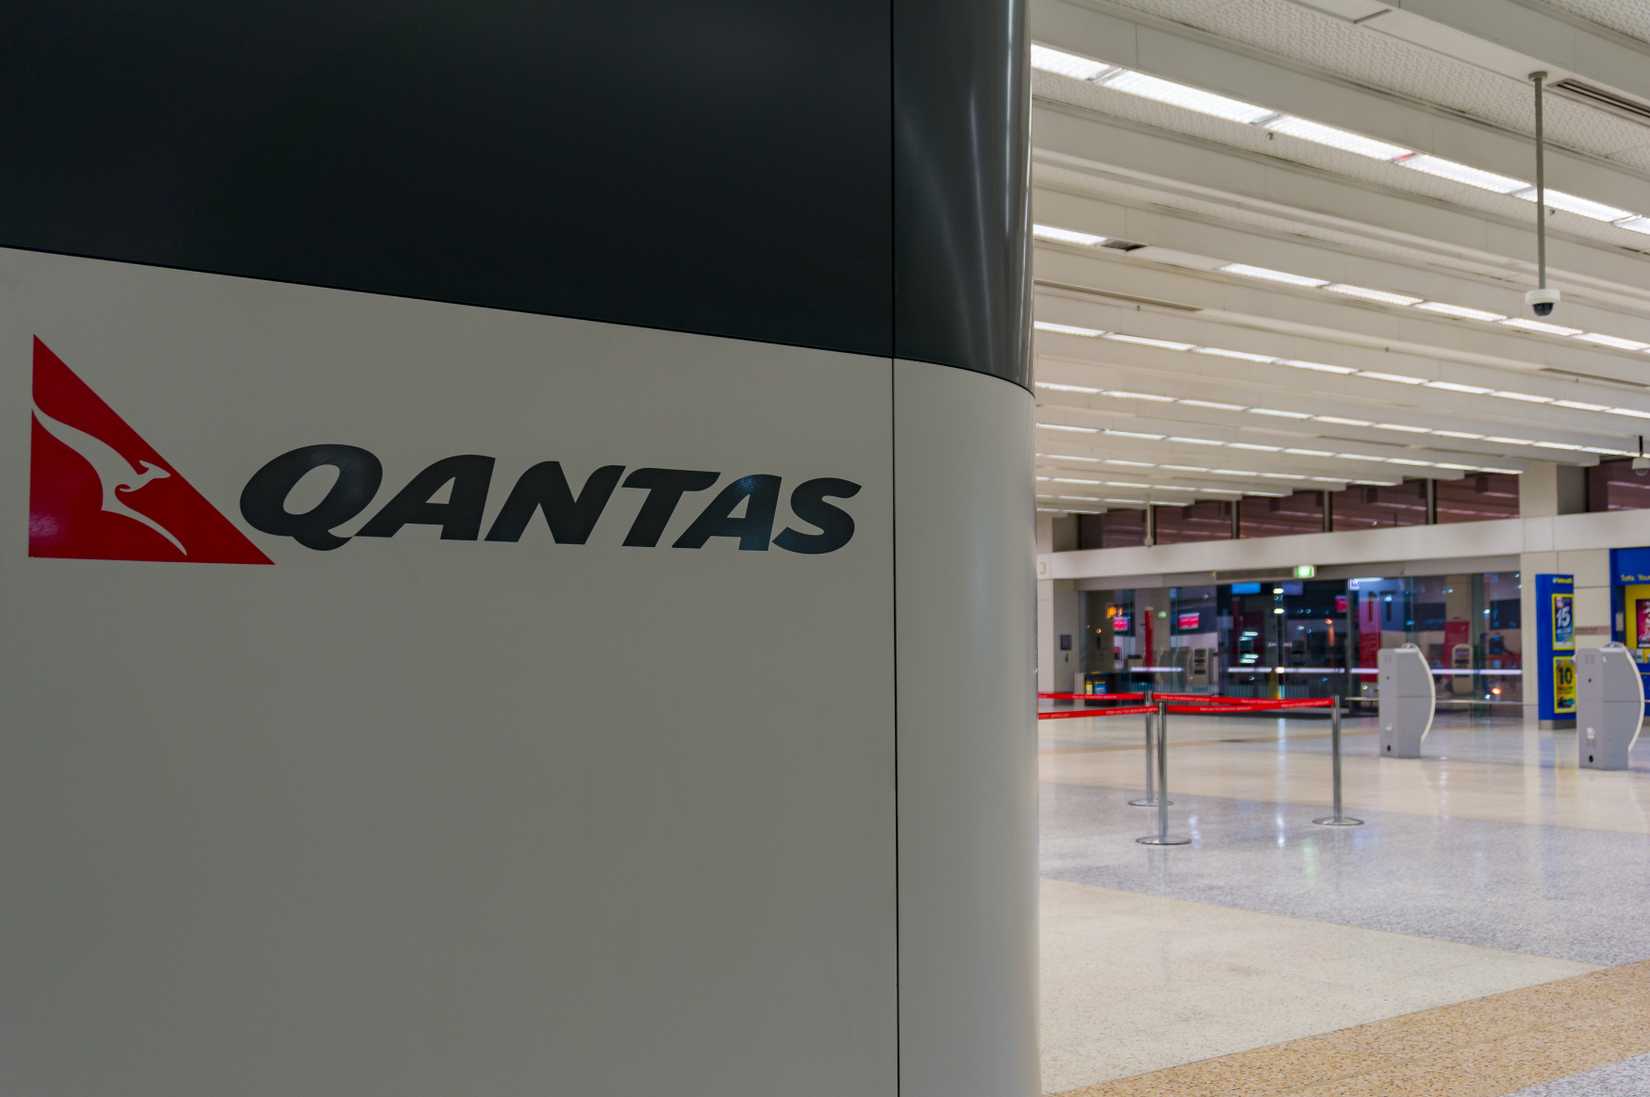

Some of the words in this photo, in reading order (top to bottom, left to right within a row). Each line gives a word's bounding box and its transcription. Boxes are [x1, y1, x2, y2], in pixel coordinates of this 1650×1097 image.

[240, 444, 862, 554] QANTAS
[1556, 606, 1571, 627] 15
[1558, 667, 1573, 685] 10
